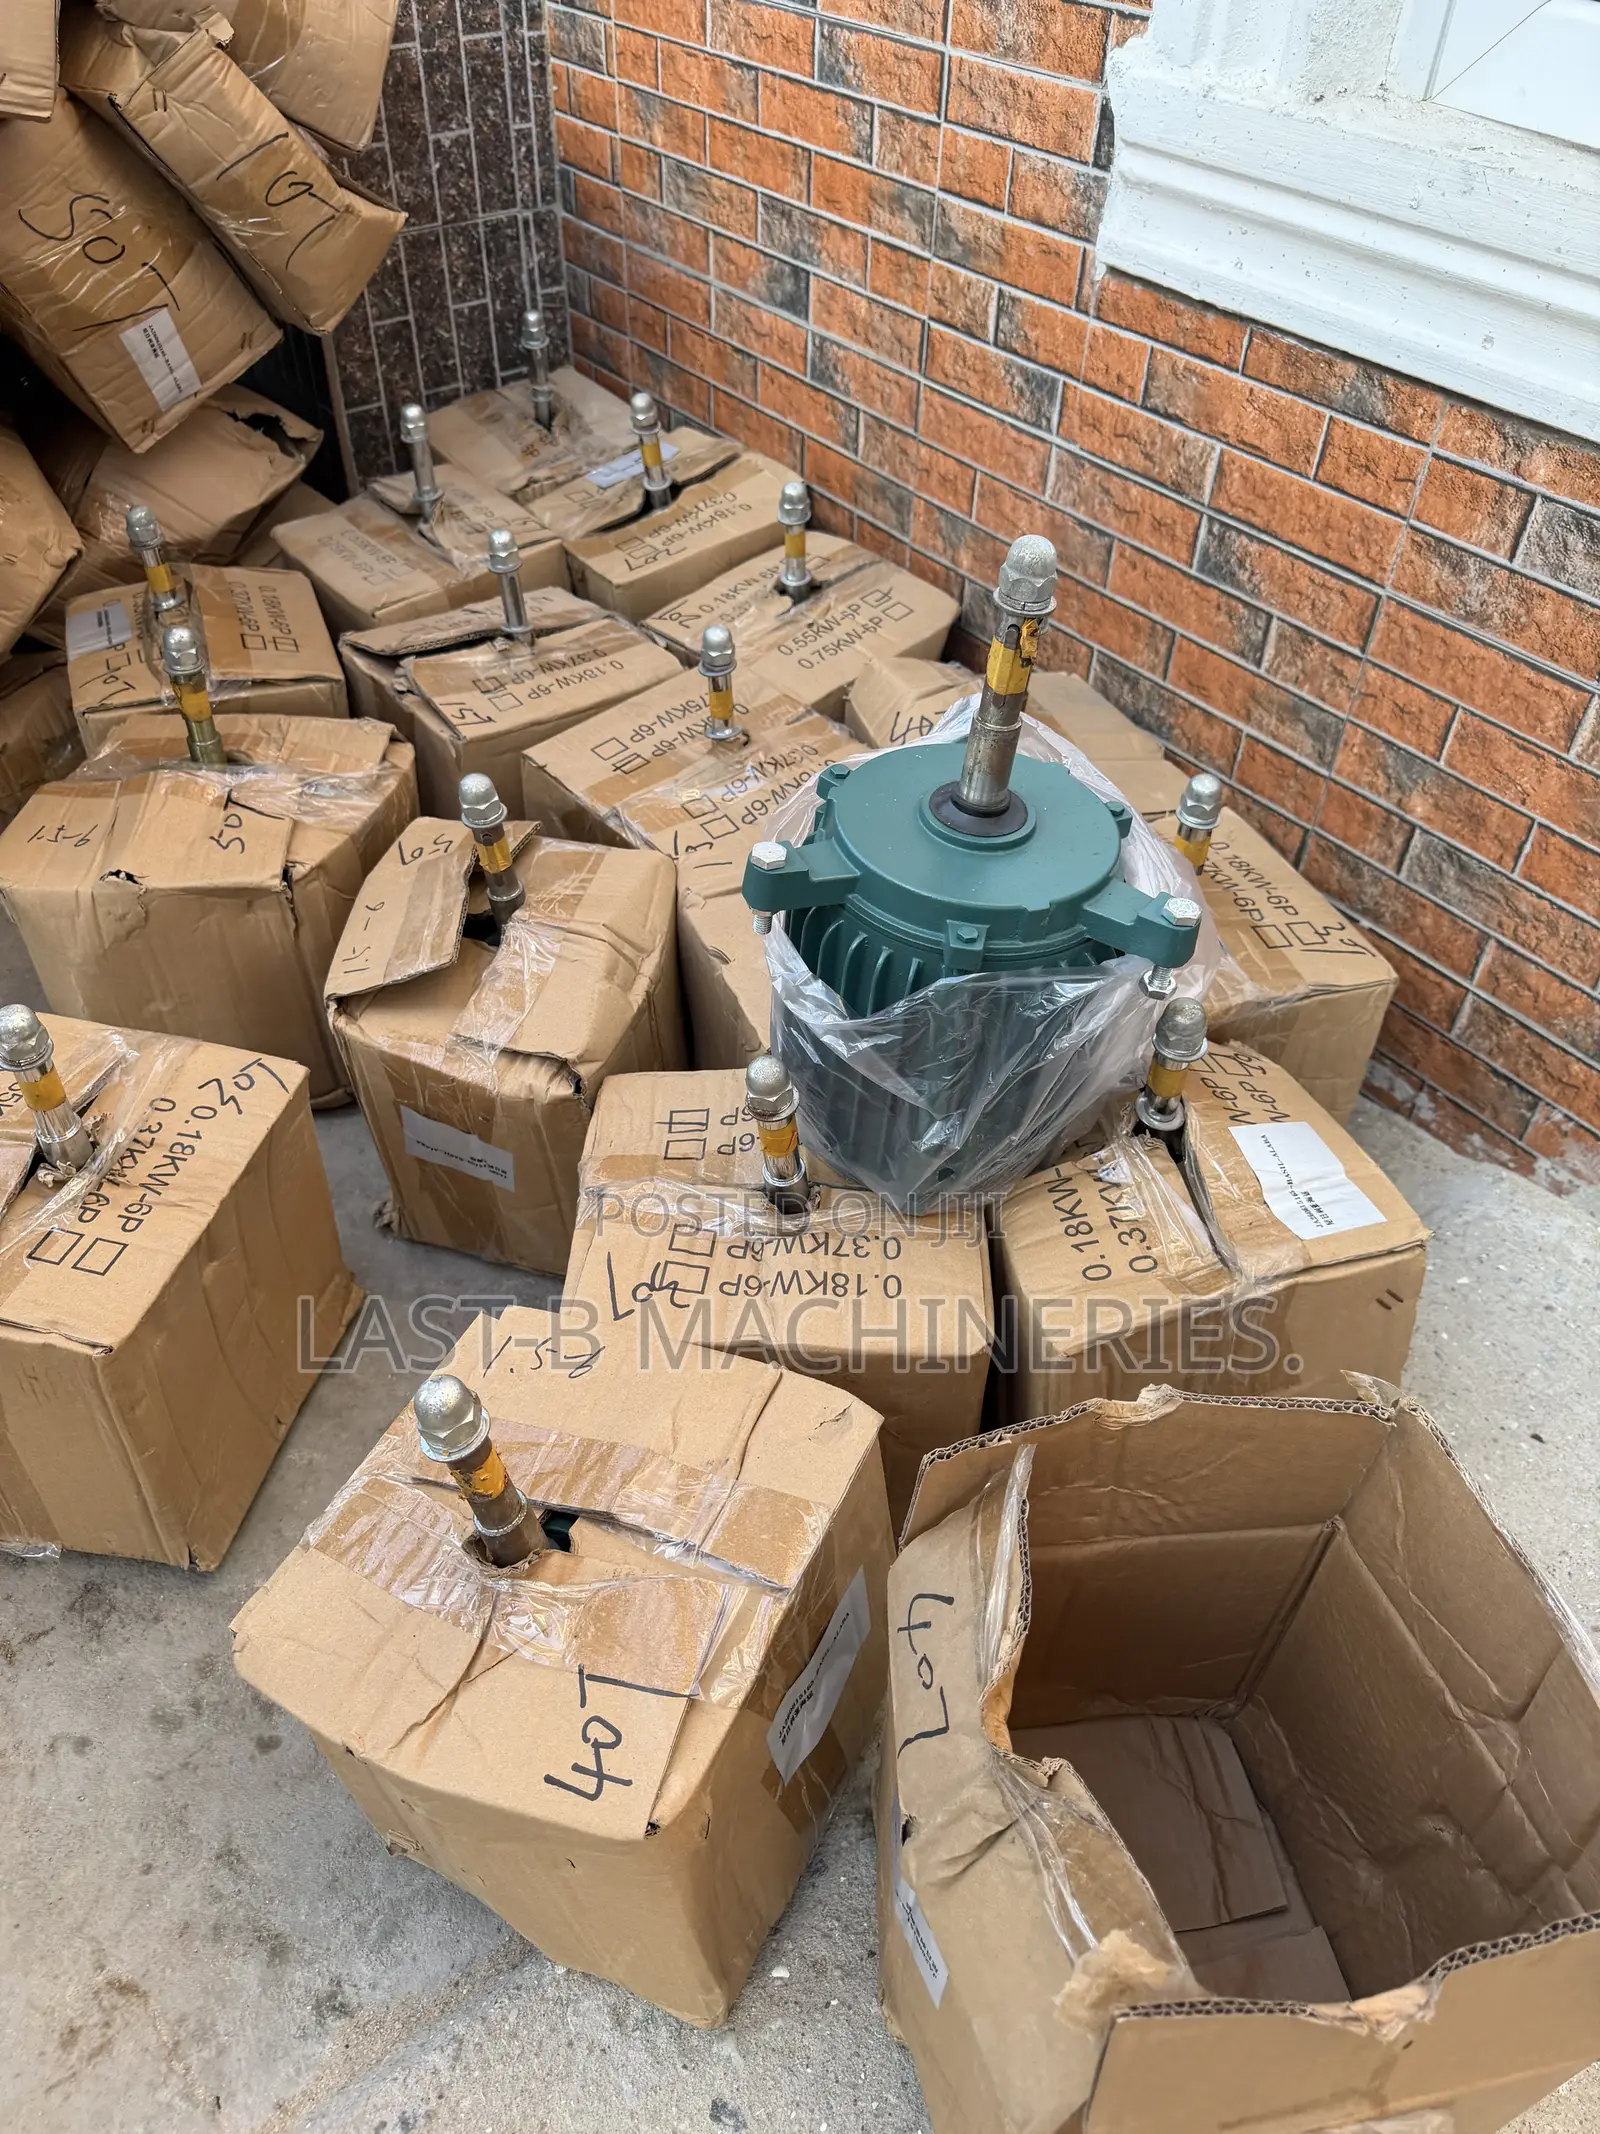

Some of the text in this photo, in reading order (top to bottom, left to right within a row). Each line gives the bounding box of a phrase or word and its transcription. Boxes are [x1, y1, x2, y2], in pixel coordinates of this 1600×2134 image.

[660, 503, 753, 548] 0.18KW-6P
[796, 615, 884, 671] 0.75KW-6P
[526, 659, 626, 701] 0.18KW-6P
[1208, 840, 1299, 917] 0.18KW-6P
[116, 1104, 218, 1235] 0.18KW-6P
[718, 1269, 903, 1300] 0.18KW-6P
